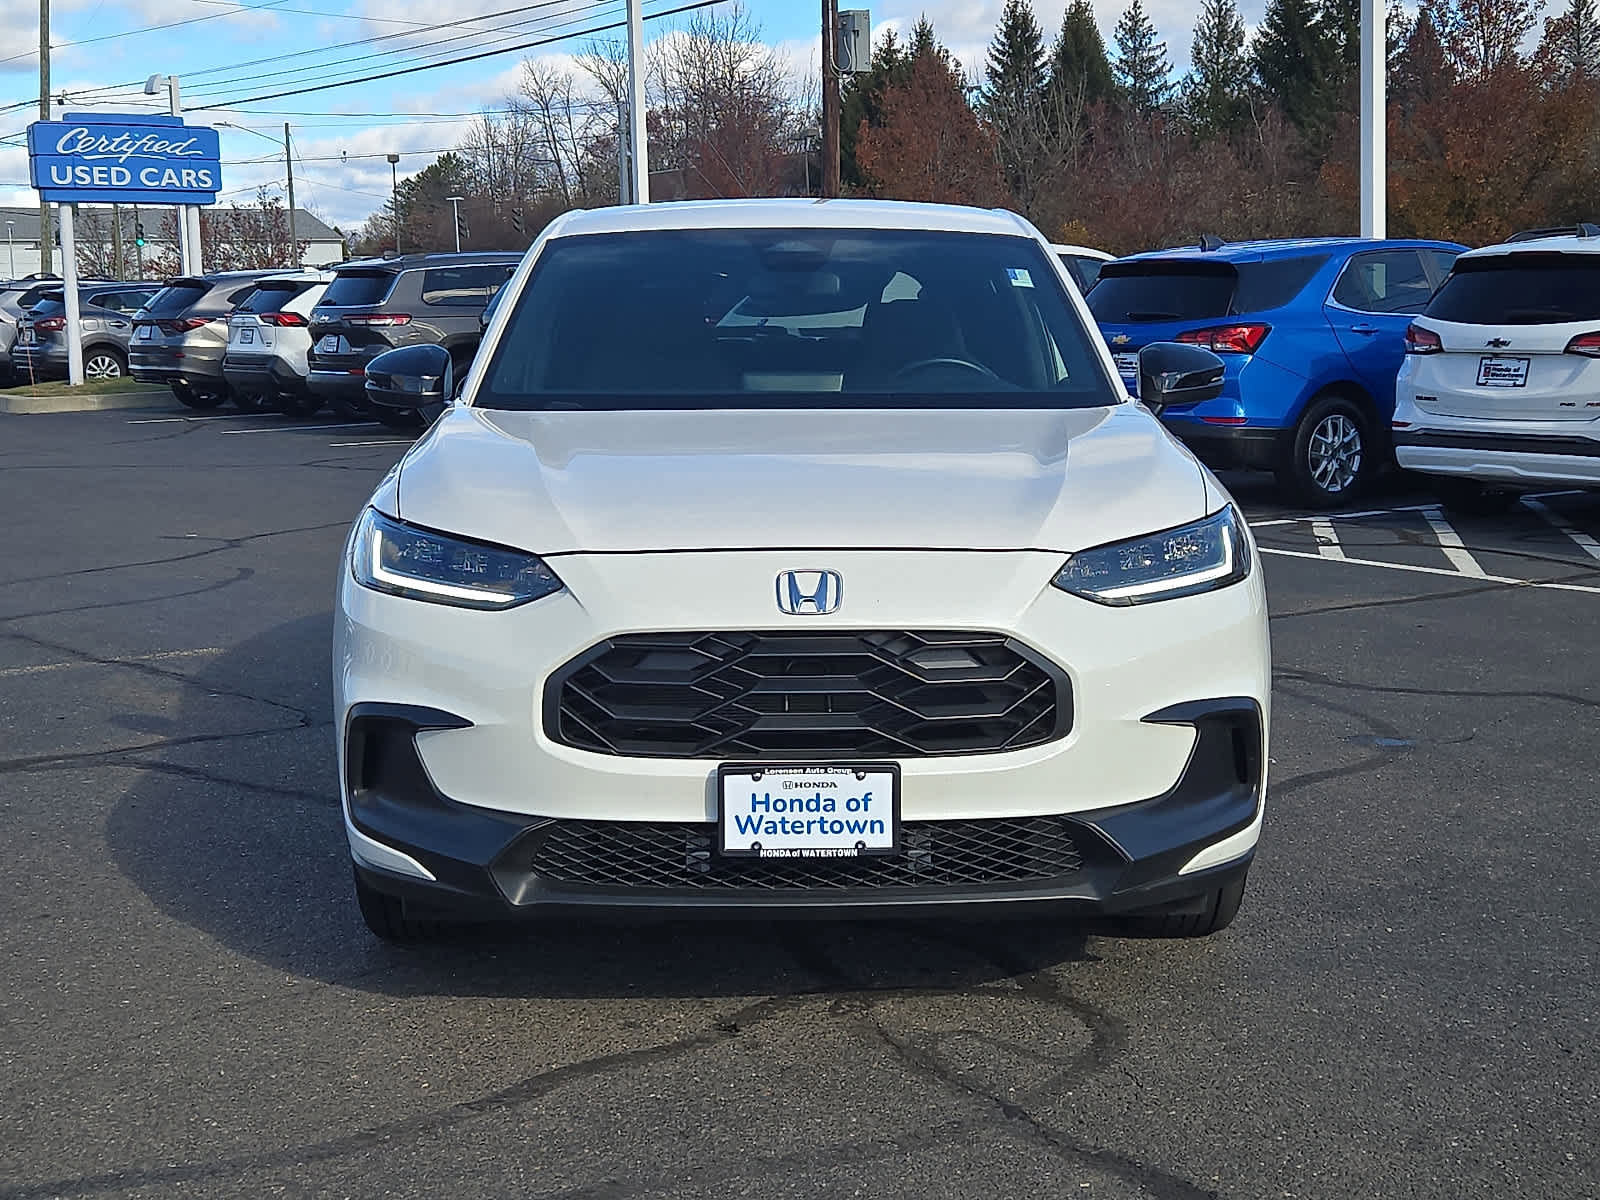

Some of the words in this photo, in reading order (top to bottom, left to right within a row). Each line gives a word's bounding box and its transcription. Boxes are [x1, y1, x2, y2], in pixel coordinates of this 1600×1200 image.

[56, 127, 203, 163] Certified
[51, 166, 131, 186] USED
[139, 168, 213, 188] CARS
[827, 768, 853, 776] Group
[751, 792, 836, 813] Honda
[845, 792, 873, 812] of
[735, 814, 885, 835] Watertown
[760, 849, 791, 858] HONDA
[791, 849, 801, 858] of
[801, 849, 858, 858] WATERTOWN
